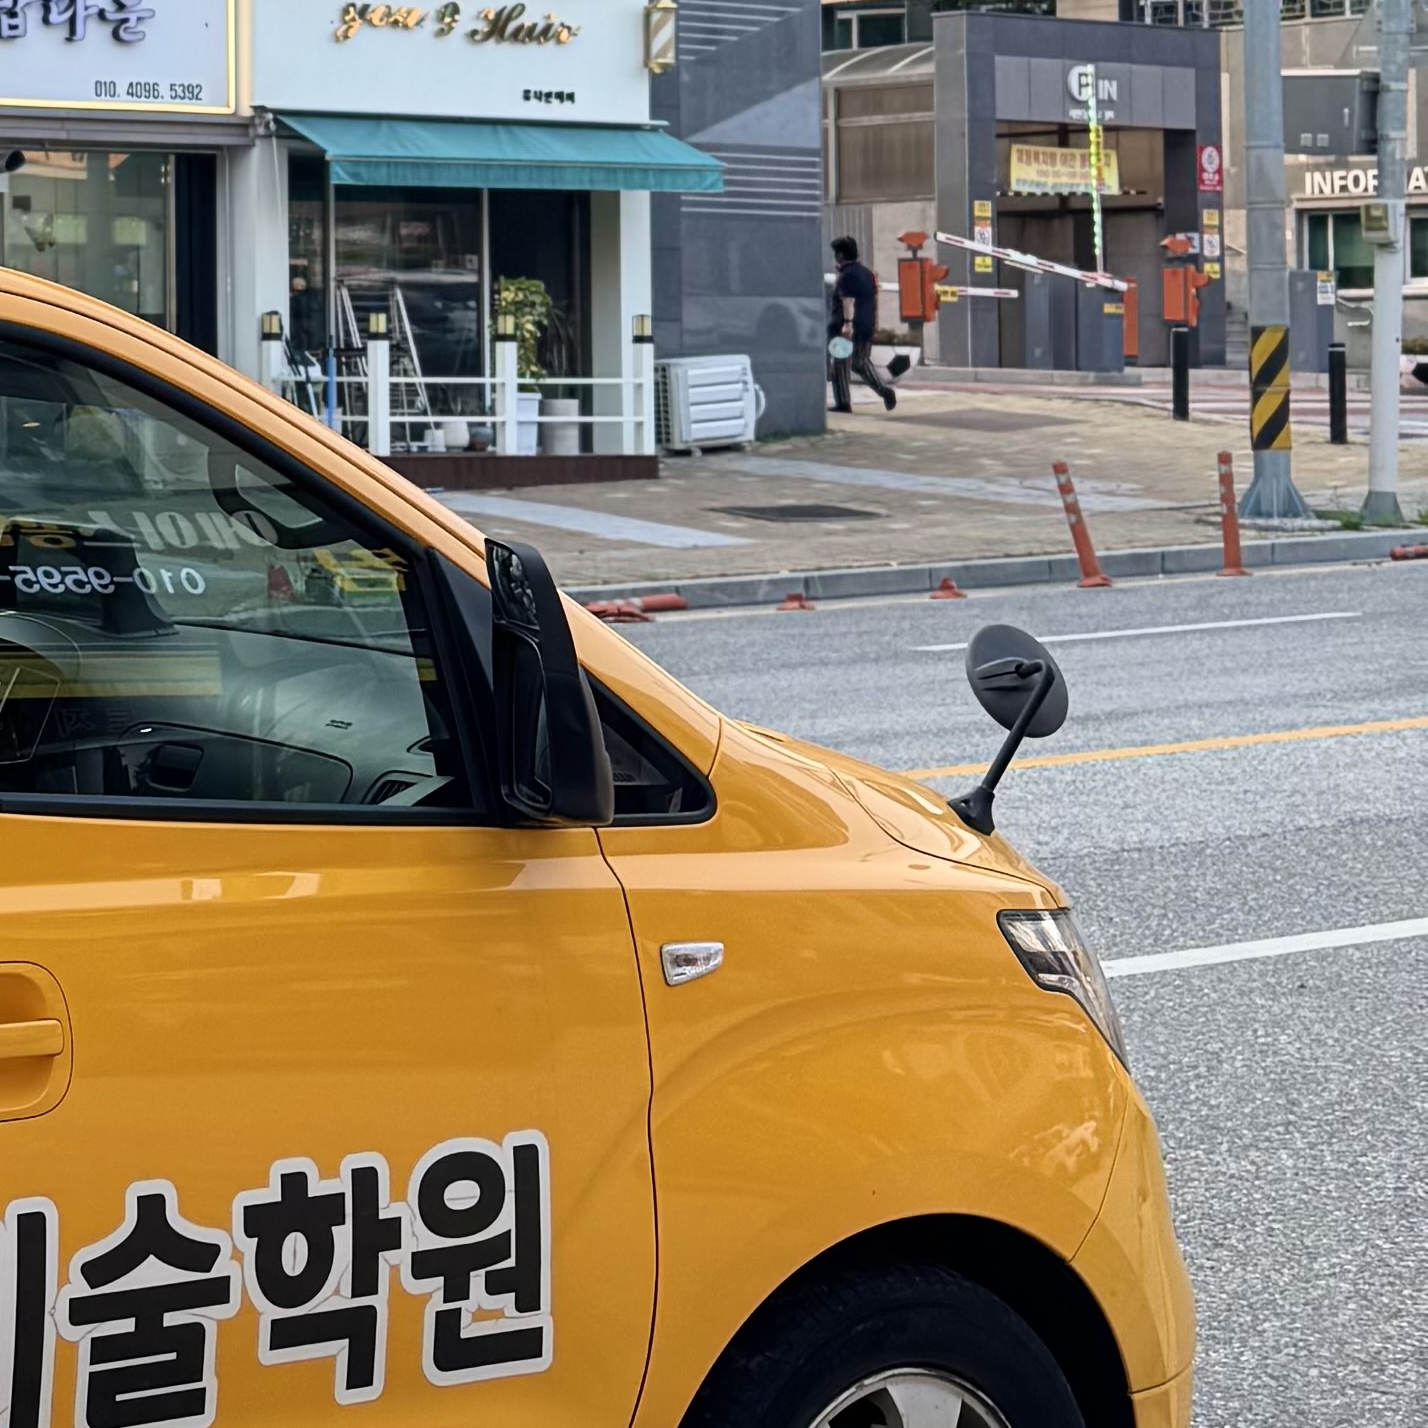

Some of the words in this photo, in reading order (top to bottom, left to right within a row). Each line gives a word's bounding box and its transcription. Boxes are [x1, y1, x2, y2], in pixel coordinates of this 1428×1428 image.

[95, 80, 121, 99] 010.
[126, 81, 165, 100] 4096.
[170, 83, 203, 102] 5392
